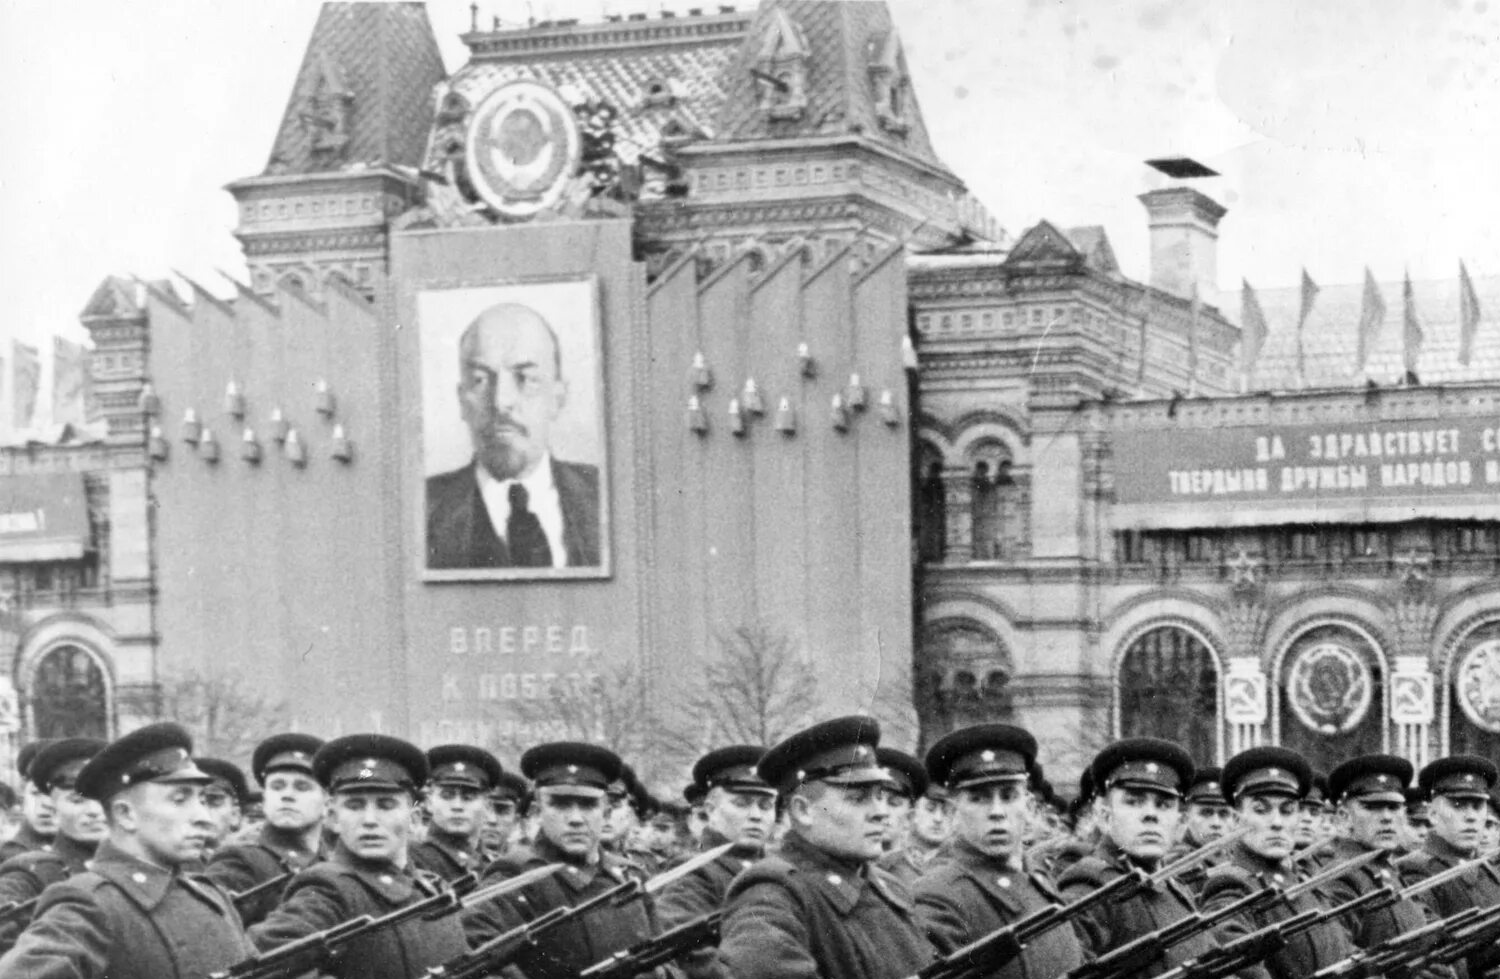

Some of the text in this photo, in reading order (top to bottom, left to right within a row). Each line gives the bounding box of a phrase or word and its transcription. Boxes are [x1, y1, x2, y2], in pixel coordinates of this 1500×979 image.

[1255, 434, 1286, 462] ДА
[1308, 428, 1460, 460] ЗДРАВСТВУЕТ
[1281, 463, 1368, 492] ДРУЖБЫ
[1381, 459, 1473, 487] НАРОДОВ
[450, 624, 591, 656] ВПЕРЕД
